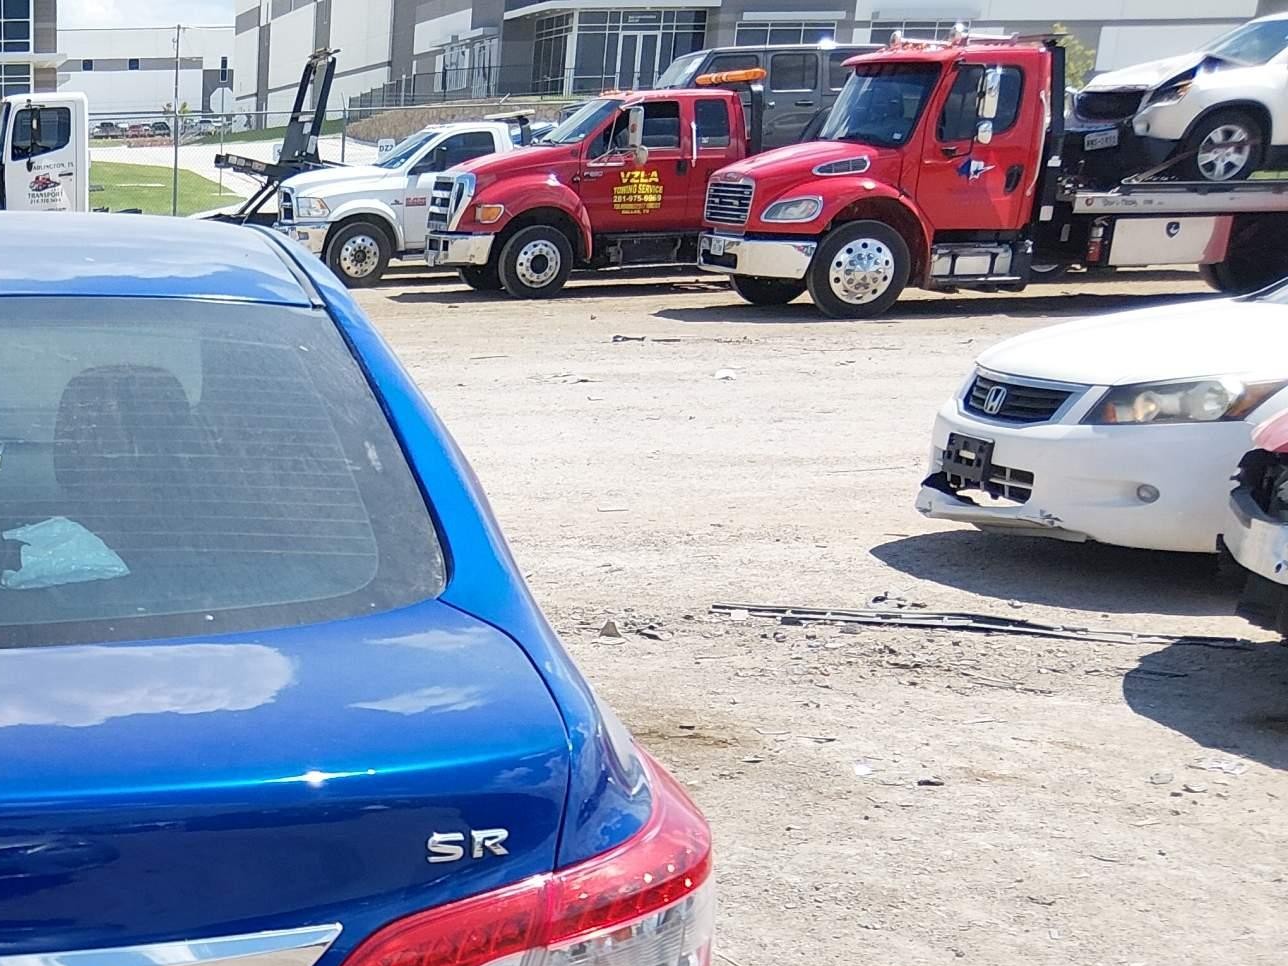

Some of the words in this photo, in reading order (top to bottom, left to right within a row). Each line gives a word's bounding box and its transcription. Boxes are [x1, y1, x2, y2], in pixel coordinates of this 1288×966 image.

[620, 170, 660, 183] VZLA
[613, 185, 637, 194] TOWING
[638, 184, 663, 193] SERVICE
[427, 828, 510, 863] SR
